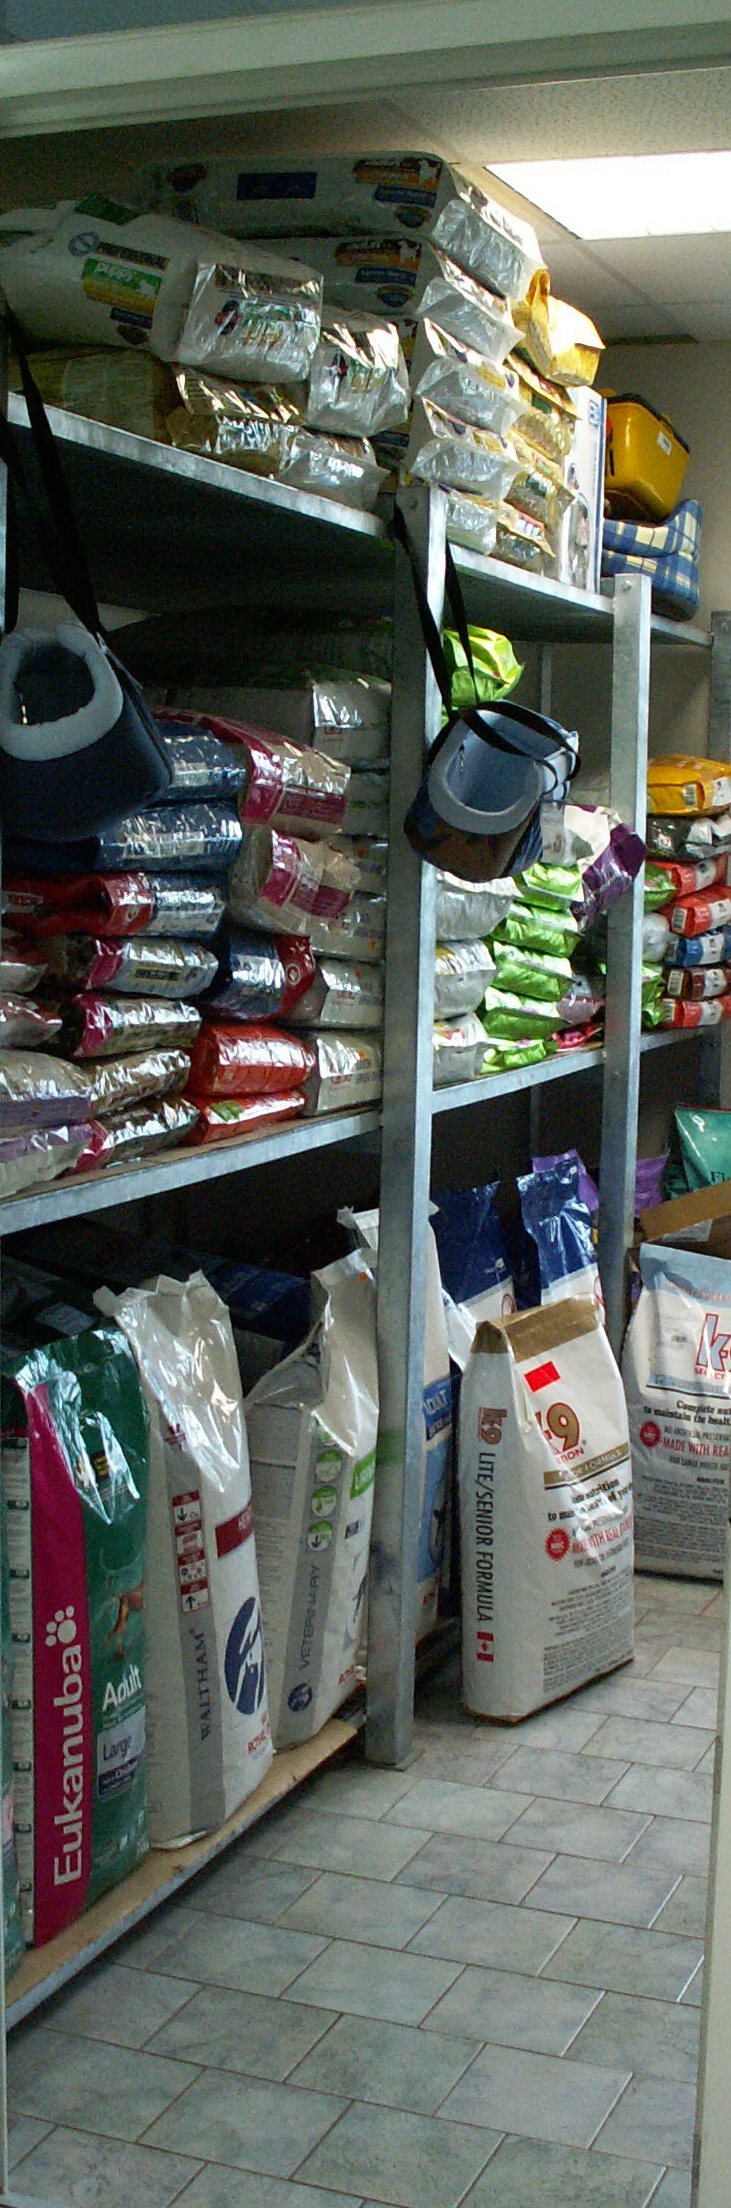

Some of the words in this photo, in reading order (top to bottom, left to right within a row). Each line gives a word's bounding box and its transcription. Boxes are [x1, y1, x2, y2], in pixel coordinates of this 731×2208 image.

[475, 1452, 496, 1546] LITE/SENIOR
[299, 1564, 319, 1670] VETERINARY
[476, 1551, 495, 1623] FORMULA
[102, 1664, 142, 1711] Adult
[193, 1632, 211, 1741] WALTHAM
[53, 1644, 83, 1886] Eukanuba
